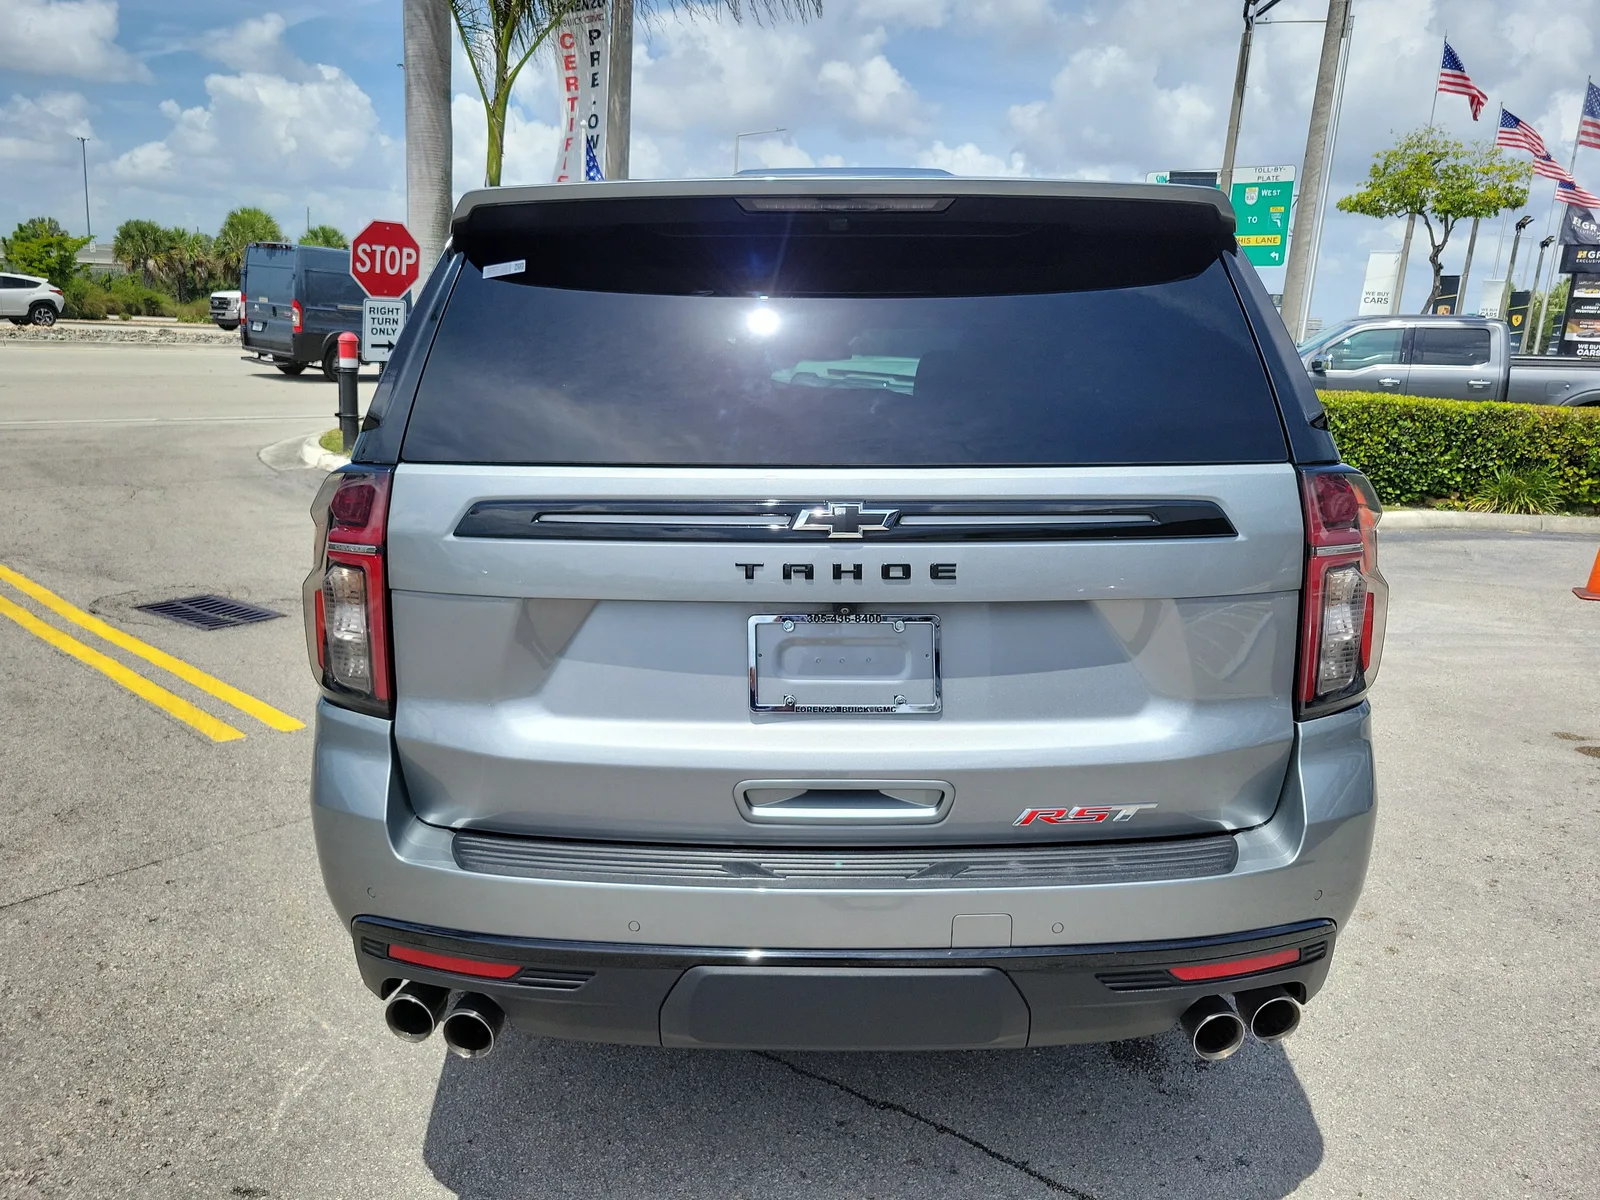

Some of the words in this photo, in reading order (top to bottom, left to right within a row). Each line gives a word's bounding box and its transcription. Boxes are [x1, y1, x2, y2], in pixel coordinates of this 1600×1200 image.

[1261, 188, 1281, 197] WEST
[1247, 216, 1258, 224] TO
[1255, 236, 1279, 244] LANE
[355, 243, 417, 276] STOP
[1363, 297, 1389, 305] CARS
[369, 306, 401, 316] RIGHT
[371, 317, 399, 326] TURN
[371, 327, 397, 336] ONLY
[735, 562, 957, 581] TAHOE
[806, 613, 882, 624] 305-436-8400
[795, 705, 837, 714] LORENZO
[842, 705, 870, 714] BUICK
[876, 705, 897, 714] GMC
[1012, 801, 1159, 827] RST
